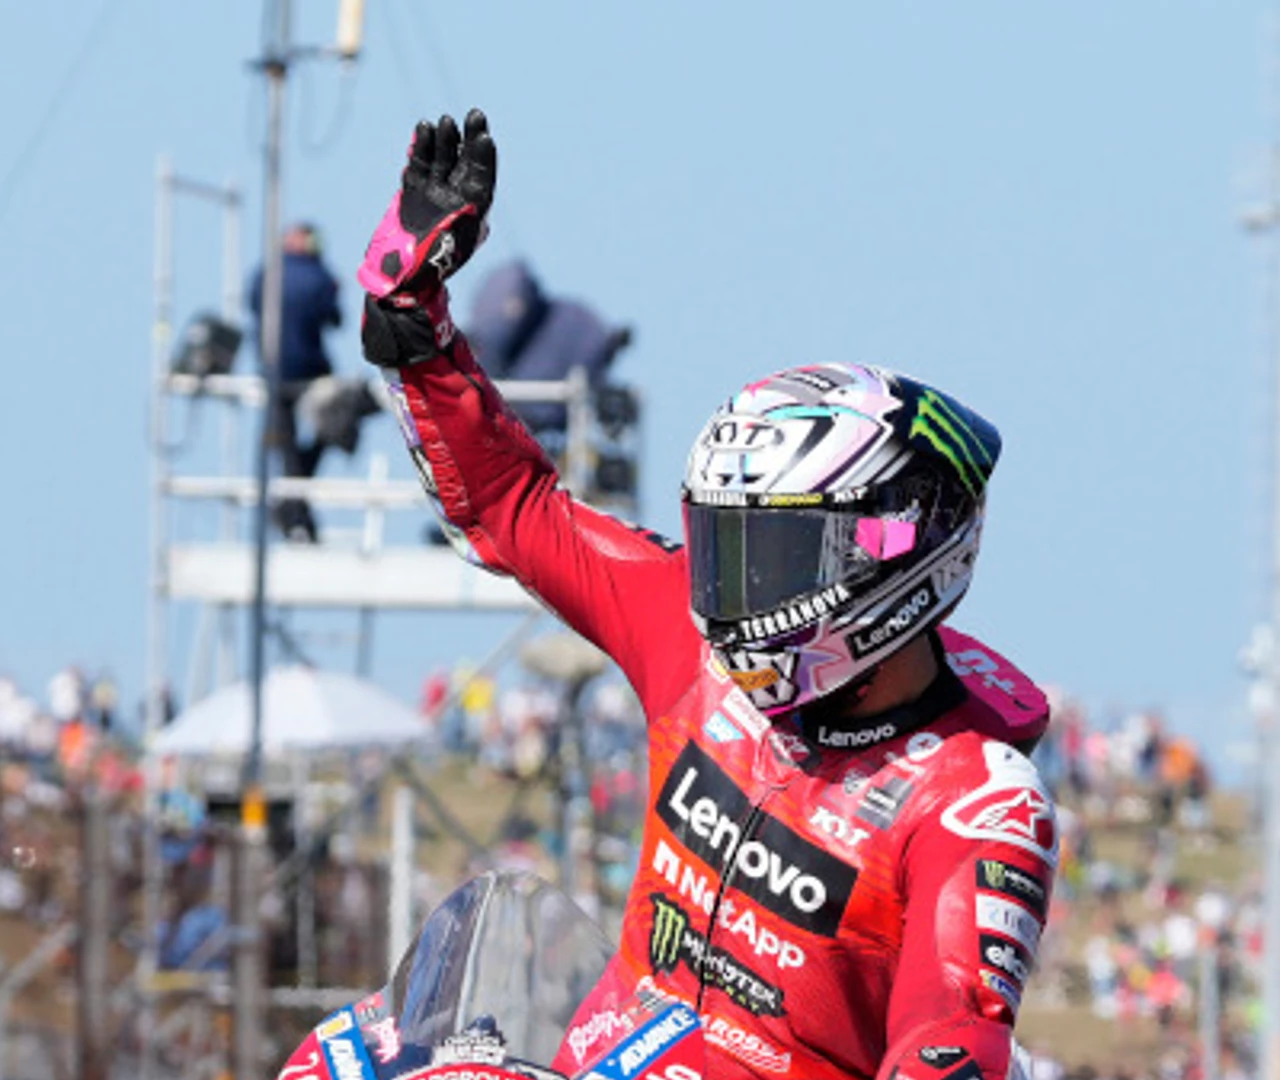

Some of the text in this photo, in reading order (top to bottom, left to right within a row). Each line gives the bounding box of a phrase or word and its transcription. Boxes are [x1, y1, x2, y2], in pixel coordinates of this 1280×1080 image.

[740, 581, 850, 641] TERRANOVA
[853, 590, 930, 650] Lenovo
[818, 723, 897, 747] Lenovo
[669, 767, 827, 912] Lenovo
[678, 866, 806, 969] NetApp
